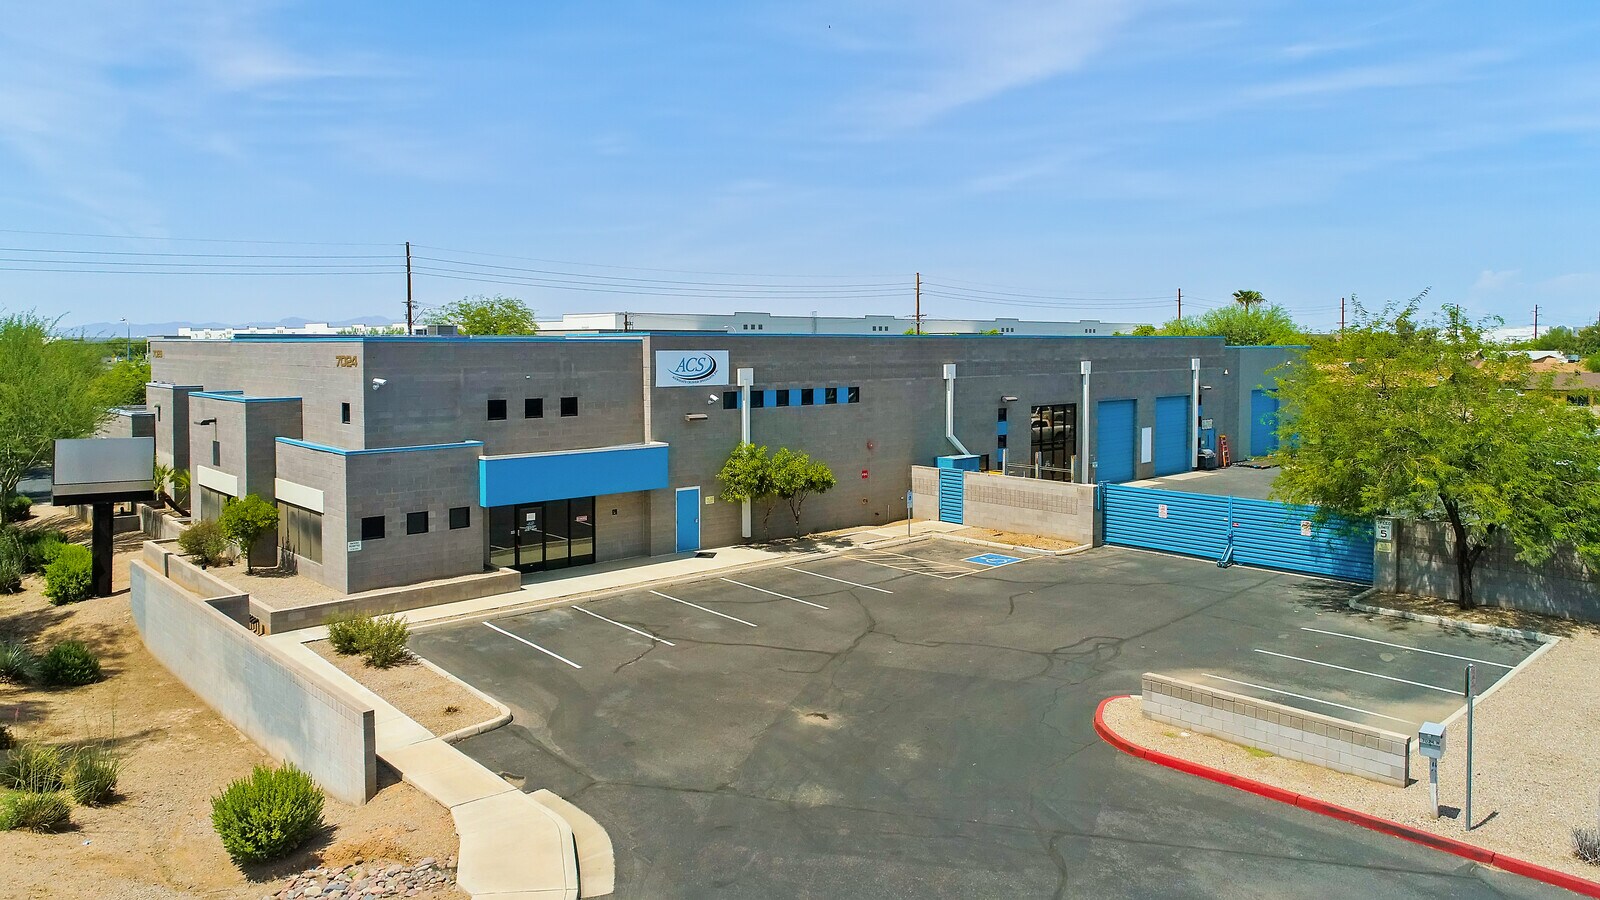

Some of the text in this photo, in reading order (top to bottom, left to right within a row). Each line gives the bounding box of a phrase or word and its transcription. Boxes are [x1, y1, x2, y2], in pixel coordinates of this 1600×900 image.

[336, 355, 358, 367] 7024
[675, 357, 706, 373] ACS
[1380, 529, 1388, 538] 5
